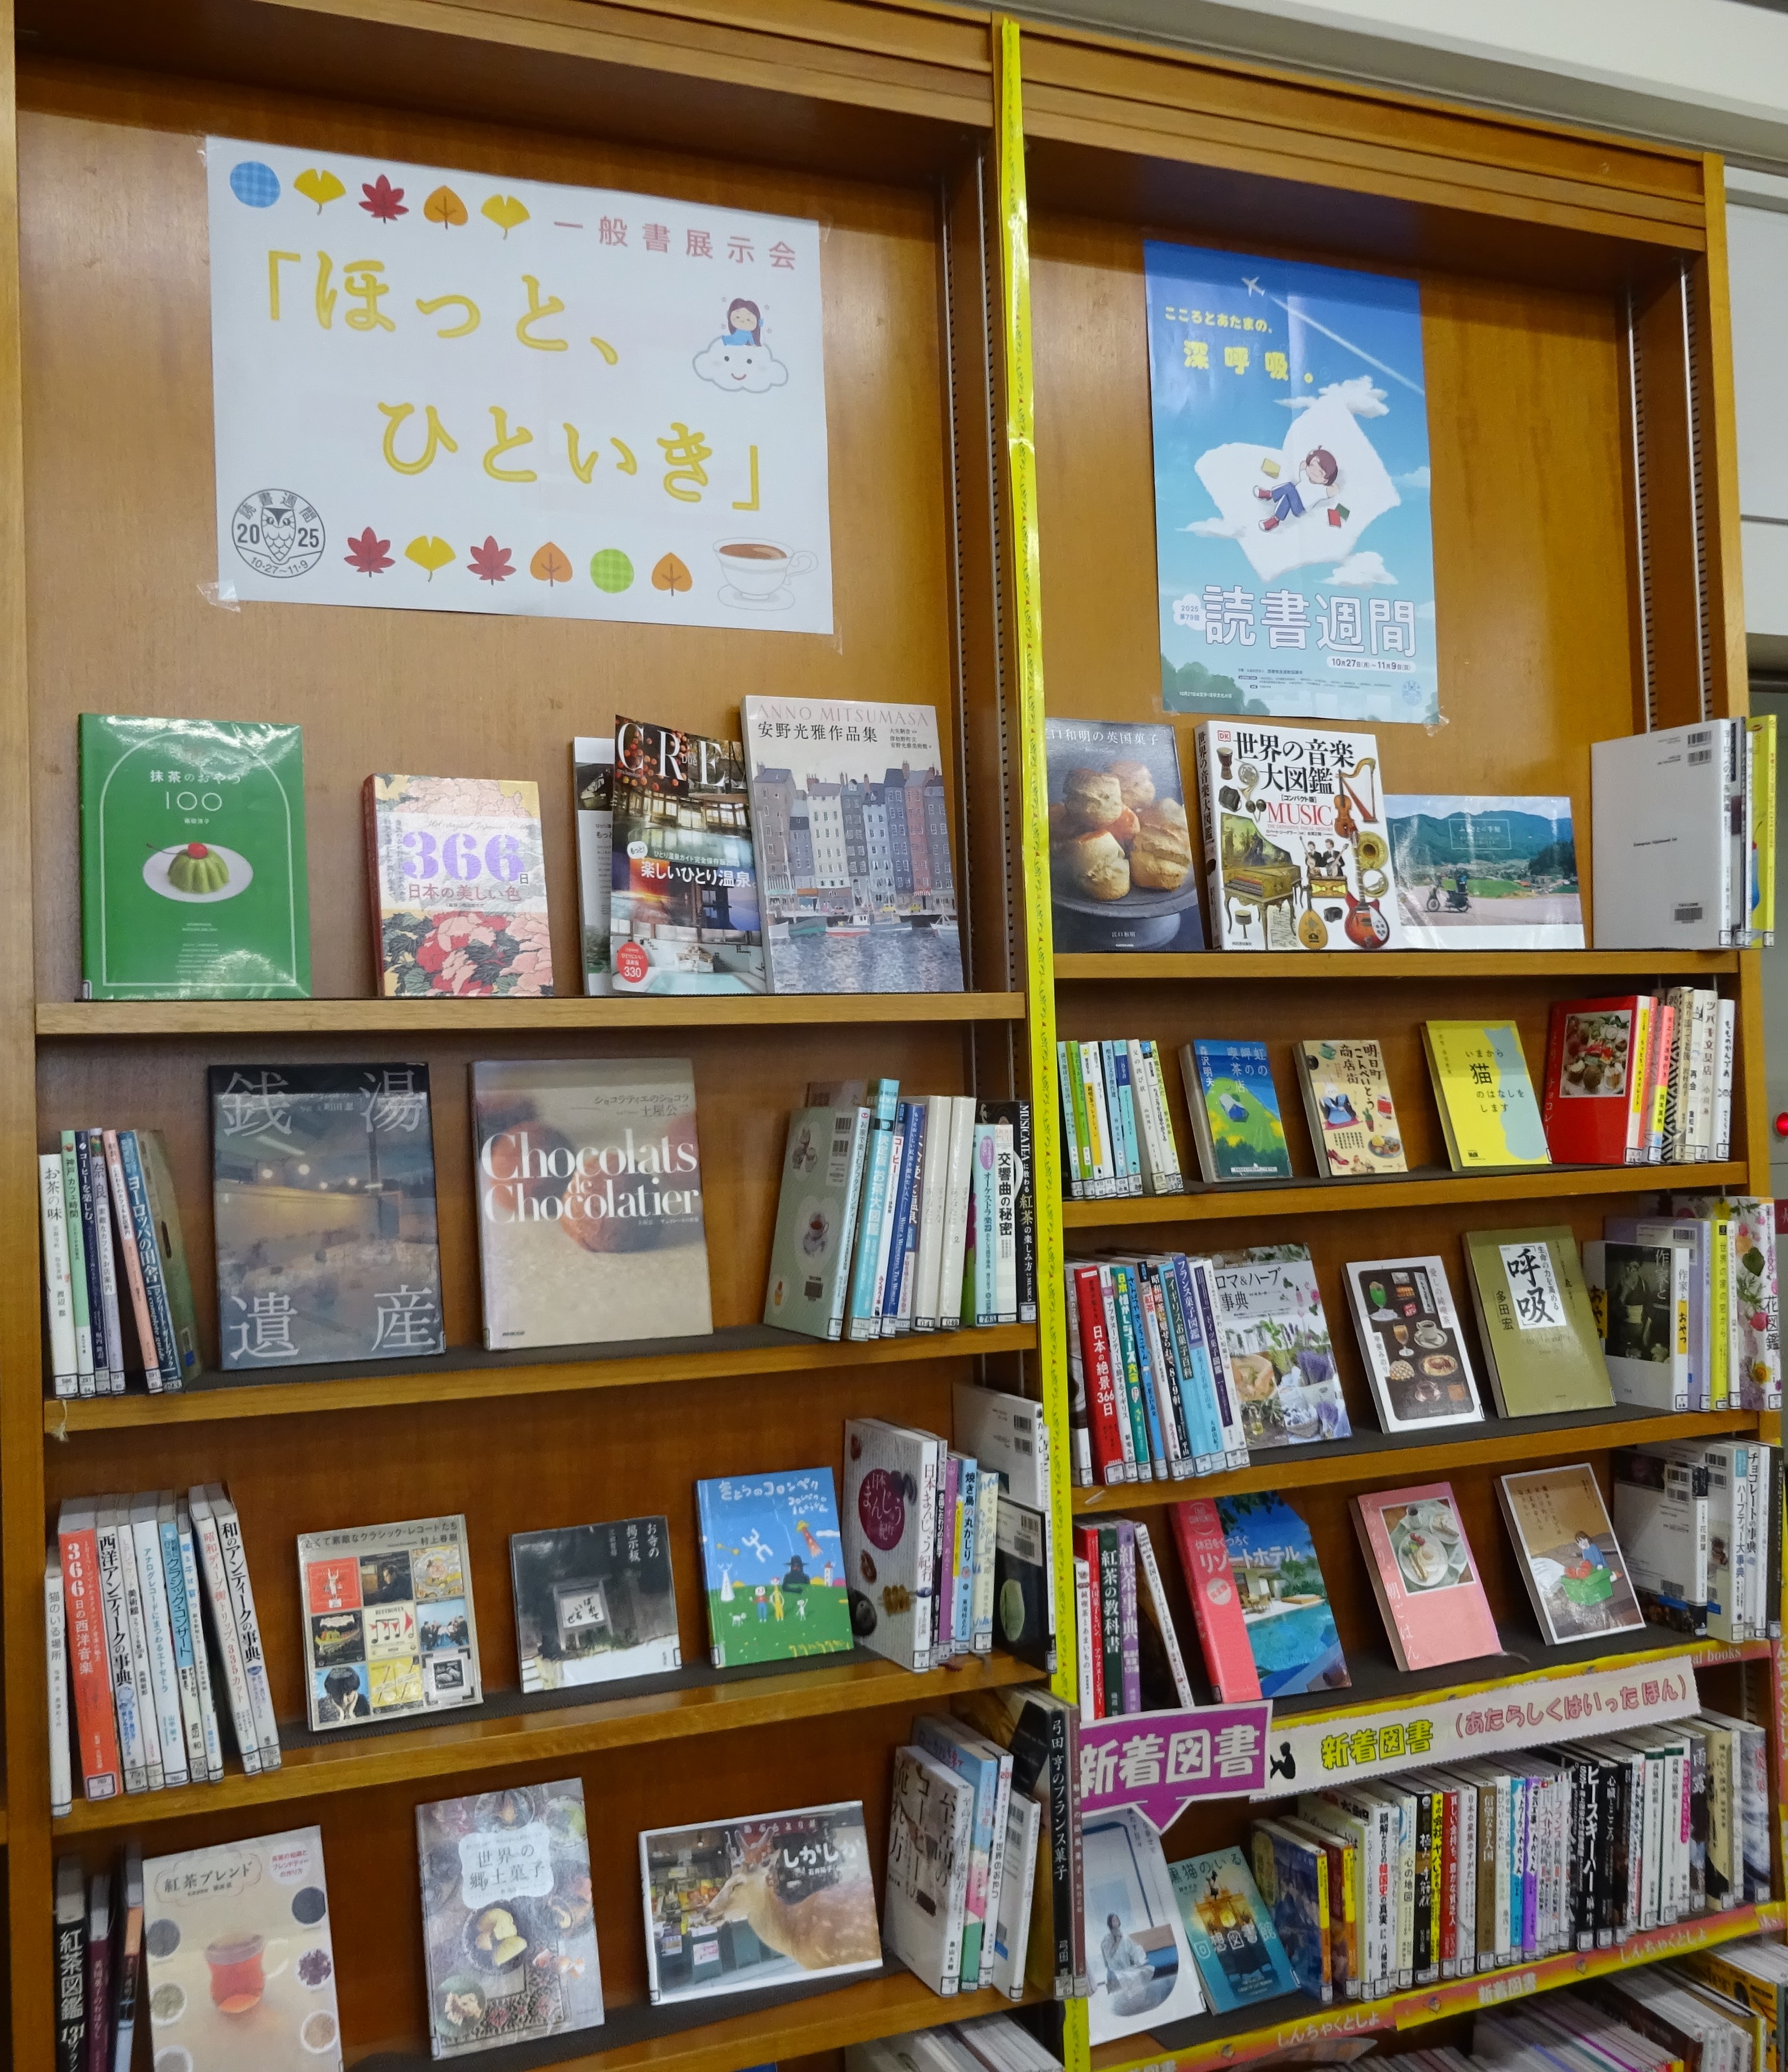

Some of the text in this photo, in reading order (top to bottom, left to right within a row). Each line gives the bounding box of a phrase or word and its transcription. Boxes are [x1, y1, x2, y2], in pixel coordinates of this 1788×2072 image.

[554, 215, 796, 271] 一般書展示会
[267, 250, 619, 365] 「ほっと、
[1164, 306, 1273, 334] こころとあたまの、
[1183, 339, 1314, 384] 深呼吸。
[378, 401, 760, 512] ひといき」
[239, 491, 318, 523] 読書週間
[237, 523, 319, 548] 20 25
[1202, 585, 1417, 657] 読書週間
[757, 703, 929, 727] ANNO MITSUMASA
[757, 722, 878, 744] 安野光雅作品集
[1219, 732, 1229, 740] DK
[682, 755, 697, 767] Due
[1233, 731, 1355, 769] 世界の音楽
[150, 769, 242, 784] 抹茶のおやつ
[1198, 731, 1213, 841] 世界の音楽大図鑑
[1259, 762, 1335, 795] 大図鑑
[165, 791, 222, 811] 100
[1266, 802, 1334, 826] MUSIC
[409, 883, 522, 902] 日本の美しい色
[641, 861, 757, 889] 楽しいひとり温泉。
[624, 967, 641, 979] 330
[1133, 1049, 1146, 1092] 父の詫び状
[1198, 1045, 1216, 1087] 森沢明夫
[1226, 1046, 1246, 1094] 喫茶店
[1253, 1047, 1269, 1077] 虹の
[1339, 1044, 1360, 1085] 商店街
[1363, 1044, 1382, 1081] 明日町
[1465, 1048, 1504, 1059] いまから
[1469, 1063, 1493, 1085] 猫
[594, 1093, 689, 1107] ショコラティエのショコラ
[1354, 1048, 1375, 1110] こんぺいとう
[1476, 1088, 1525, 1099] のはなしを
[221, 1070, 423, 1136] 銭湯
[1019, 1104, 1029, 1142] MUSICA
[1480, 1103, 1509, 1113] します
[481, 1129, 699, 1179] Chocolats
[893, 1137, 903, 1174] コーヒー
[1020, 1144, 1030, 1162] TEA
[45, 1167, 62, 1221] お茶の味
[80, 1153, 95, 1224] コーヒーを楽しむ。
[94, 1162, 107, 1199] 奈良
[484, 1177, 700, 1223] Chocolatier
[567, 1172, 593, 1195] de
[997, 1151, 1013, 1236] 交響曲の秘密
[983, 1172, 993, 1232] オーケストラ楽器
[1215, 1267, 1282, 1290] ロマ&ハーブ
[1537, 1246, 1559, 1311] 生命の力を高める
[1655, 1249, 1671, 1300] 作家と
[1145, 1294, 1155, 1313] 紅茶
[1177, 1261, 1202, 1341] フランス菓子図鑑
[1220, 1290, 1250, 1312] 事典
[1496, 1289, 1514, 1331] 多田宏
[1678, 1268, 1689, 1344] 作家と おやつ
[229, 1284, 436, 1361] 遺産
[1117, 1272, 1140, 1384] 日本懐かしジュース大全
[1168, 1279, 1194, 1380] イギリスお菓子百科
[1093, 1324, 1116, 1417] 日本の絶景366日
[1106, 1301, 1129, 1419] アフタヌーンティーで旅するイギリス
[917, 1464, 936, 1582] 日本まんじゅう紀行
[963, 1472, 976, 1562] 焼き鳥の丸かじり
[1747, 1451, 1759, 1555] チョコレートの事典
[420, 1533, 458, 1546] 村上春樹
[626, 1524, 641, 1563] 掲示板
[647, 1522, 660, 1559] お寺の
[1195, 1535, 1250, 1551] 休日をくつろぐ
[1200, 1544, 1301, 1574] リゾートホテル
[68, 1542, 94, 1675] 366日の西洋音楽
[98, 1533, 133, 1686] 西洋アンティークの事典
[166, 1557, 191, 1658] クラシック・コンサート
[221, 1522, 262, 1662] 和のアンティークの事典
[1101, 1549, 1120, 1654] 紅茶の教科書
[1119, 1543, 1138, 1640] 紅茶事典
[48, 1591, 62, 1662] 猫のいる場所
[144, 1548, 168, 1693] アナログレコードにまつわるエトセトラ
[1081, 1590, 1090, 1669] 純喫茶とあまいもの
[1708, 1647, 1741, 1662] books
[1081, 1724, 1261, 1798] 新着図書
[1321, 1720, 1434, 1771] 新着図書
[1051, 1718, 1067, 1881] 弓田亨のフランス菓子
[469, 1860, 546, 1890] 郷土菓子
[477, 1843, 535, 1868] 世界の
[992, 1842, 1005, 1899] 世界のおやつ
[1168, 1852, 1242, 1884] 黒猫のいる
[164, 1860, 253, 1894] 紅茶ブレンド
[1194, 1921, 1276, 1958] 回想図書館
[59, 1928, 85, 2021] 紅茶図鑑
